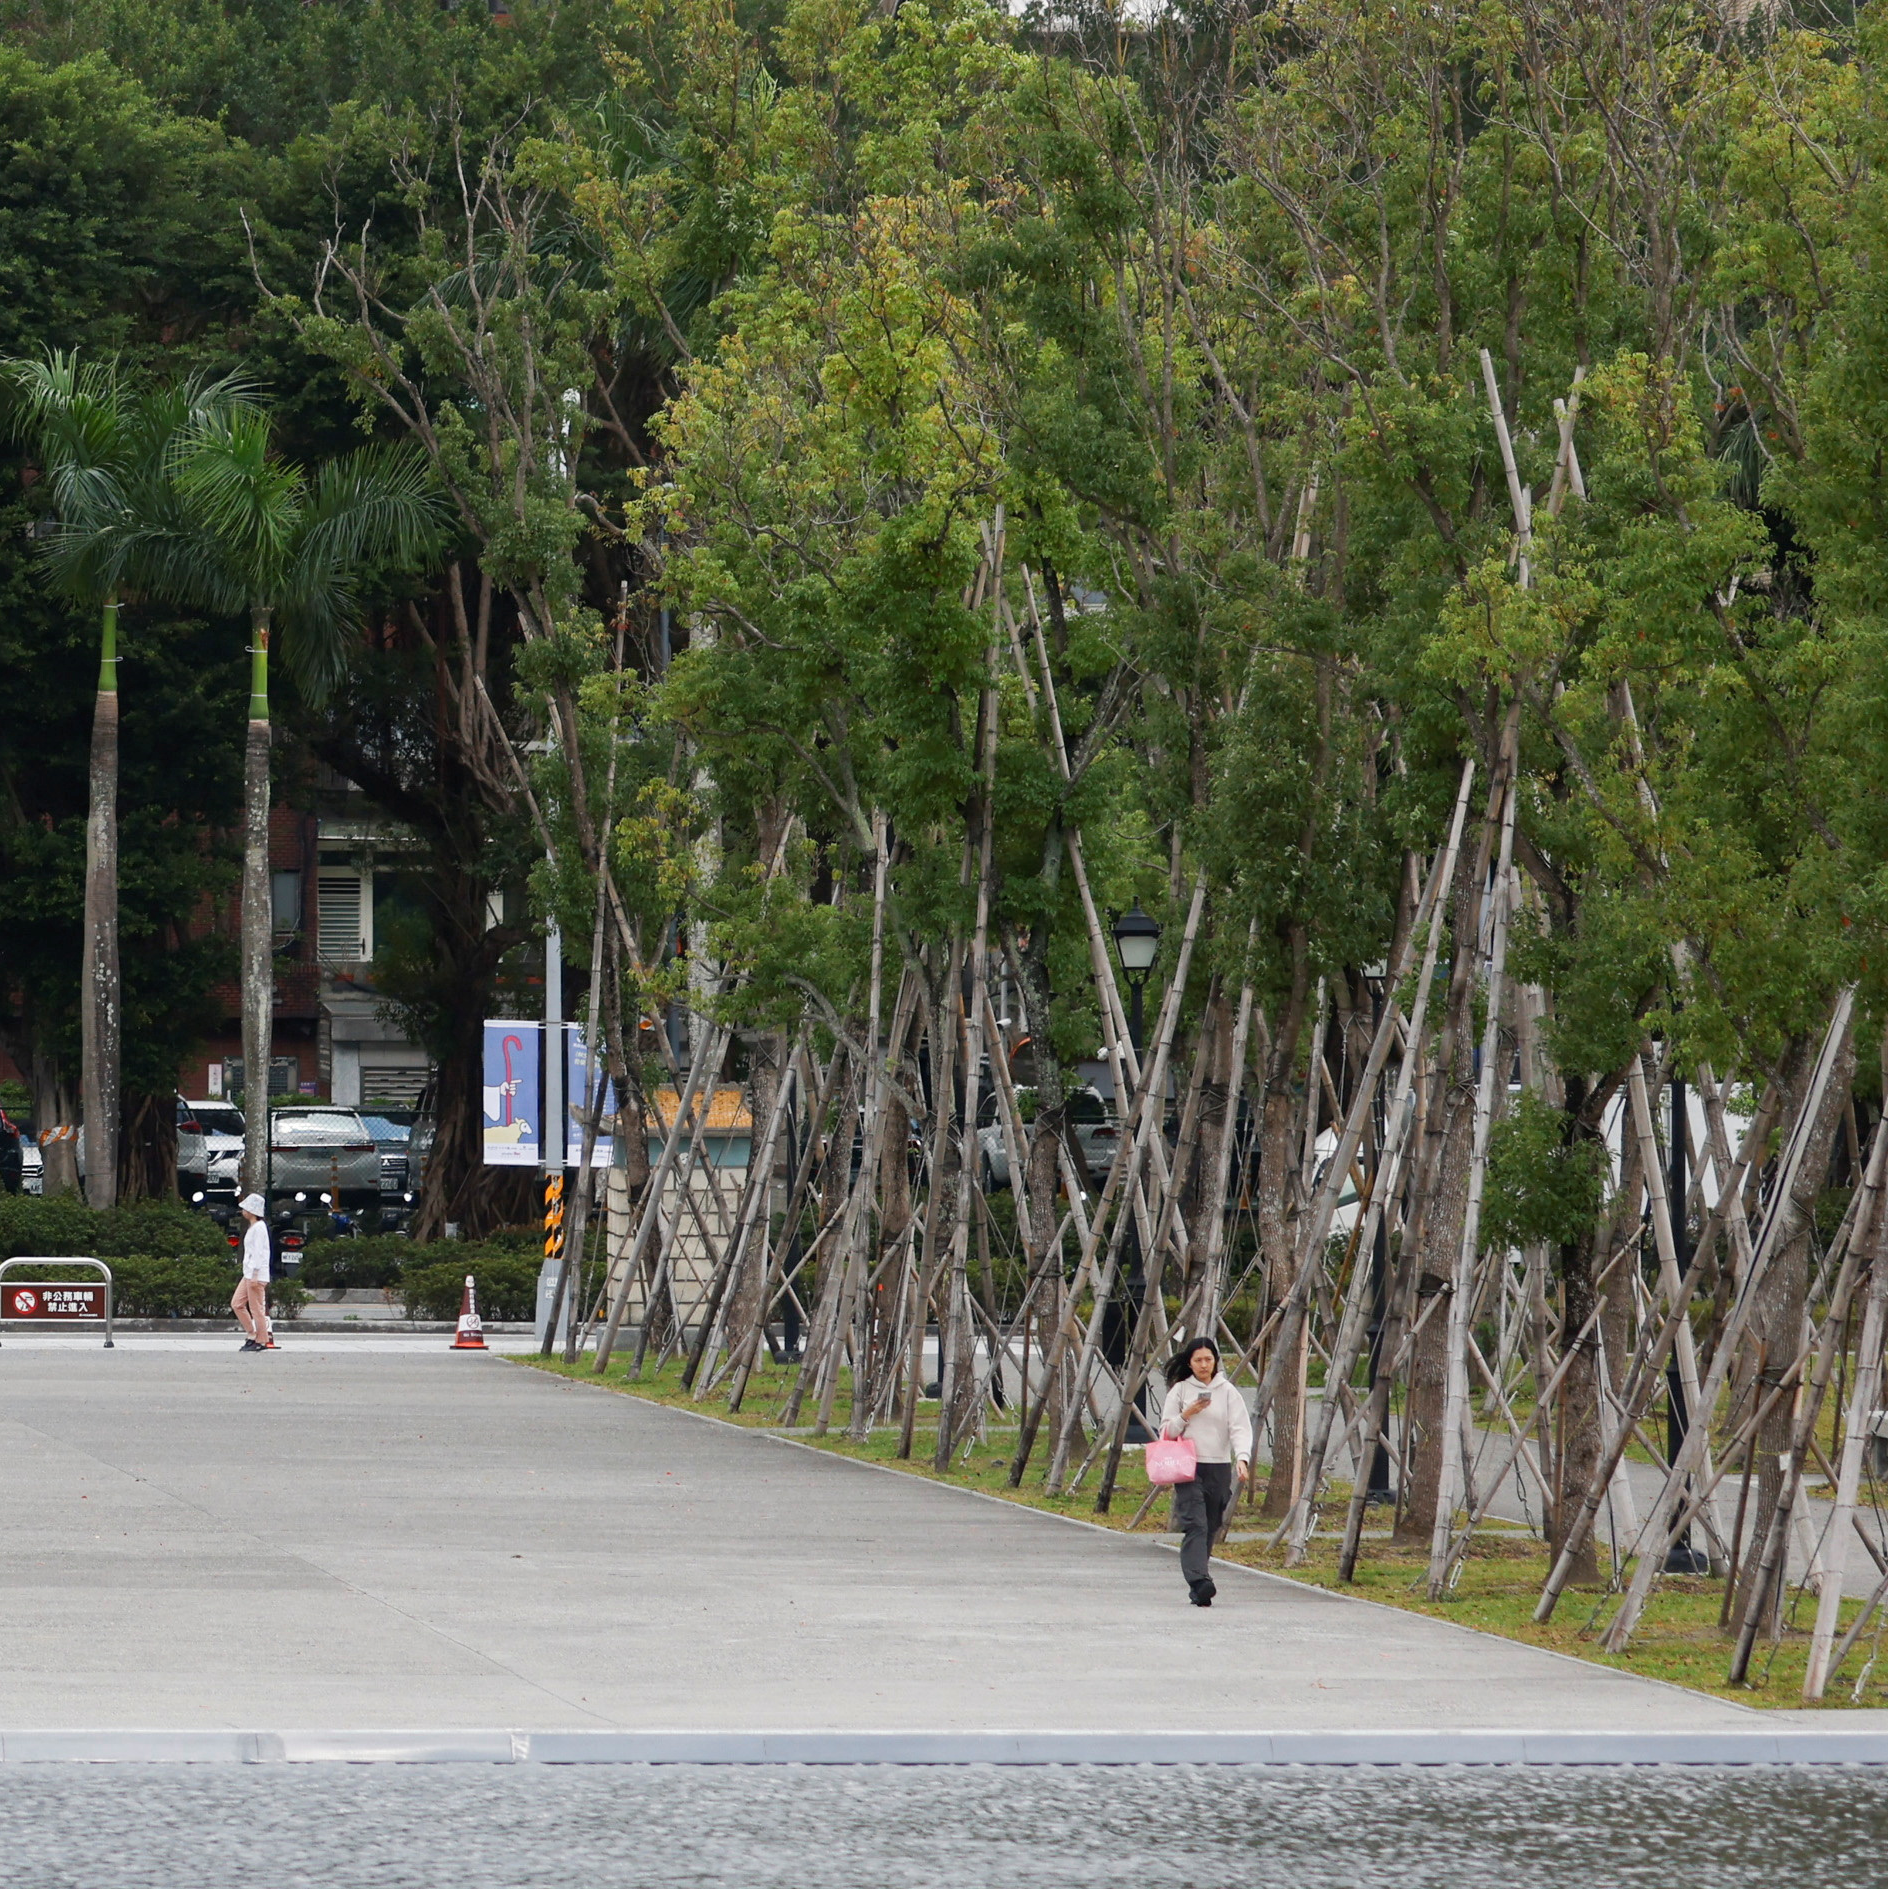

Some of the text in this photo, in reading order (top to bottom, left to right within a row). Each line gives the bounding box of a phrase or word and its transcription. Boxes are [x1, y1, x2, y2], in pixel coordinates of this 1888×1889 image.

[42, 1291, 94, 1302] 非公務車輛
[47, 1302, 88, 1313] 禁止進入
